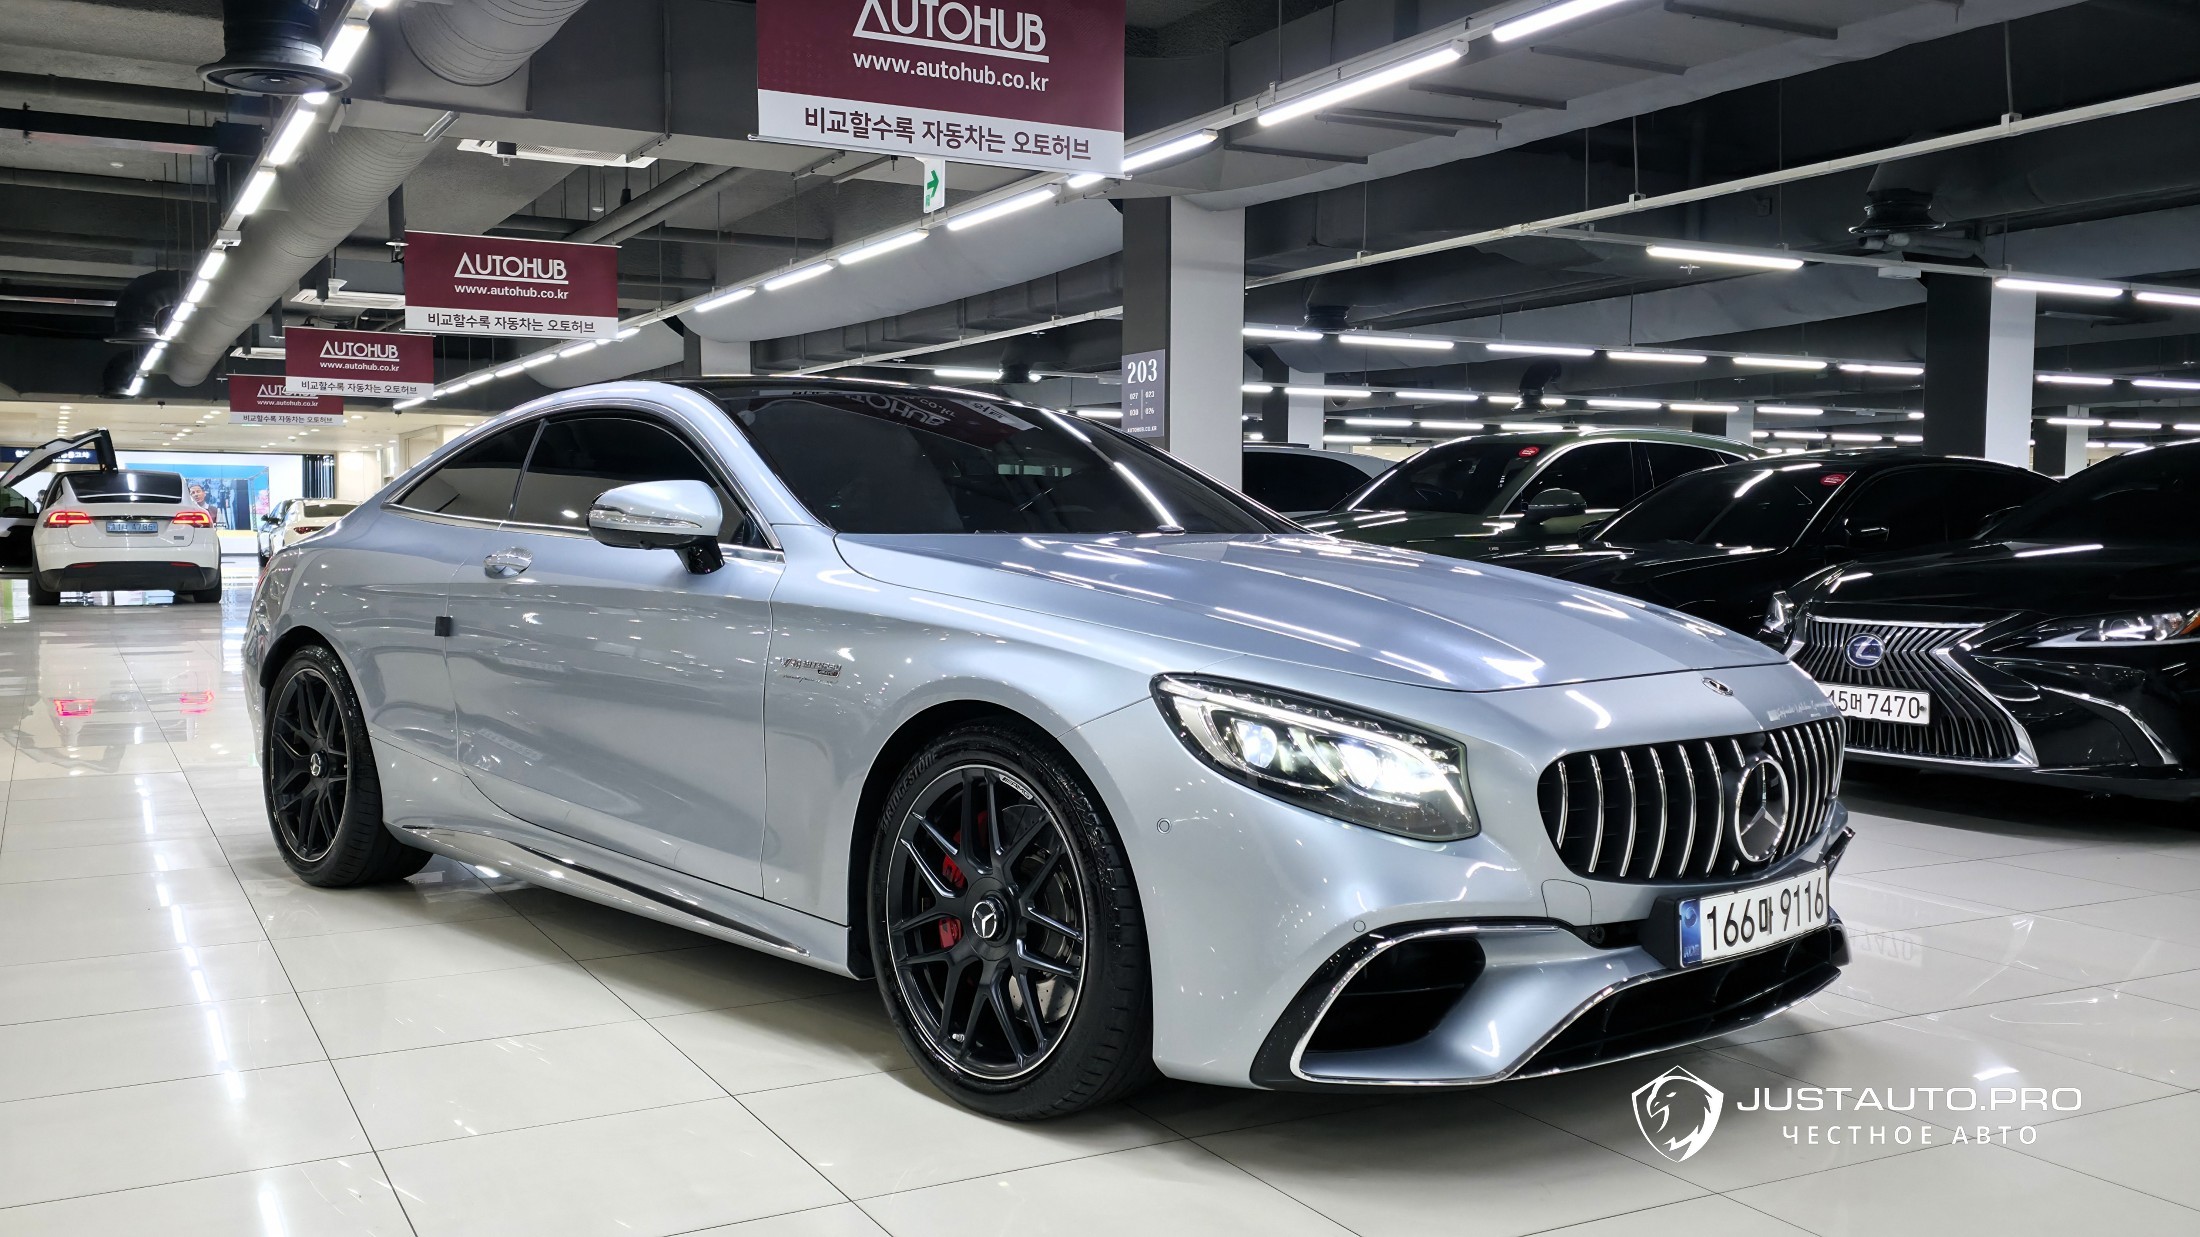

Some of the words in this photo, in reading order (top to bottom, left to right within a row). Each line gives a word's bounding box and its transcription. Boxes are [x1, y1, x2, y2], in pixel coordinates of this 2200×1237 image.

[853, 0, 1047, 53] AUTOHUB
[853, 52, 1049, 92] www.autohub.co.kr
[804, 107, 915, 144] 비교할수록
[922, 121, 1006, 154] 자동차는
[1011, 131, 1092, 161] 오토허브
[454, 252, 567, 280] AUTOHUB
[454, 284, 569, 300] www.autohub.co.kr
[428, 313, 491, 329] 비교할수록
[494, 317, 544, 332] 자동차는
[547, 320, 596, 334] 오토허브
[320, 340, 399, 359] AUTOHUB
[320, 361, 400, 372] www.autohub.co.kr
[1127, 358, 1158, 384] 203
[301, 380, 345, 392] 비교할수록
[347, 383, 382, 394] 자동차는
[384, 385, 418, 395] 오토허브
[1867, 693, 1920, 719] 7470
[1706, 896, 1774, 951] 166마
[1780, 877, 1824, 932] 9116
